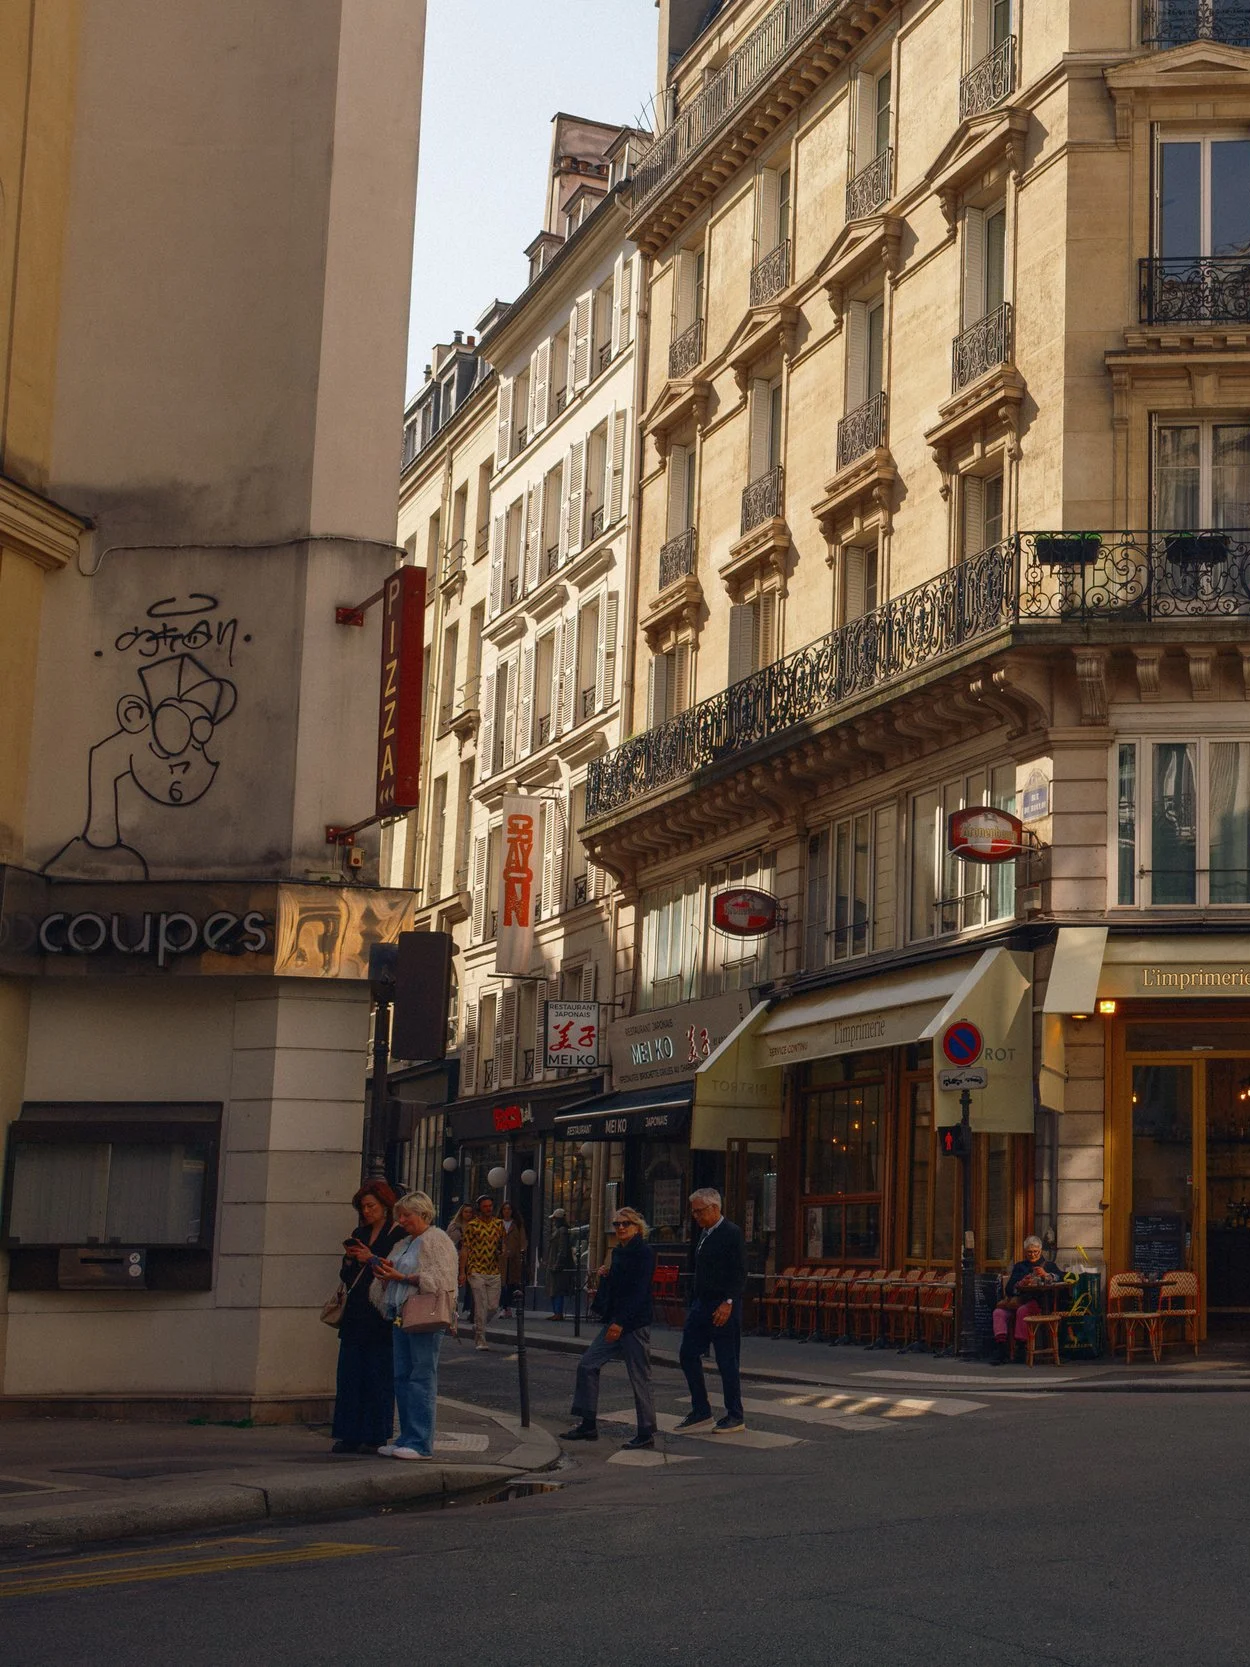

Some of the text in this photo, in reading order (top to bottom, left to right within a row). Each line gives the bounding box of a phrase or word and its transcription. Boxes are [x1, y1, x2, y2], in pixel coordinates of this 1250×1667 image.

[381, 577, 400, 782] PIZZA
[39, 911, 267, 967] coupes
[549, 1003, 596, 1011] RESTAURANT
[834, 1019, 886, 1047] L'imprimerie
[631, 1035, 674, 1066] MEI KO
[548, 1055, 596, 1065] MEI KO
[605, 1118, 627, 1134] MEI KO
[645, 1114, 668, 1128] JAPONAIS
[566, 1124, 592, 1136] RESTAURANT
